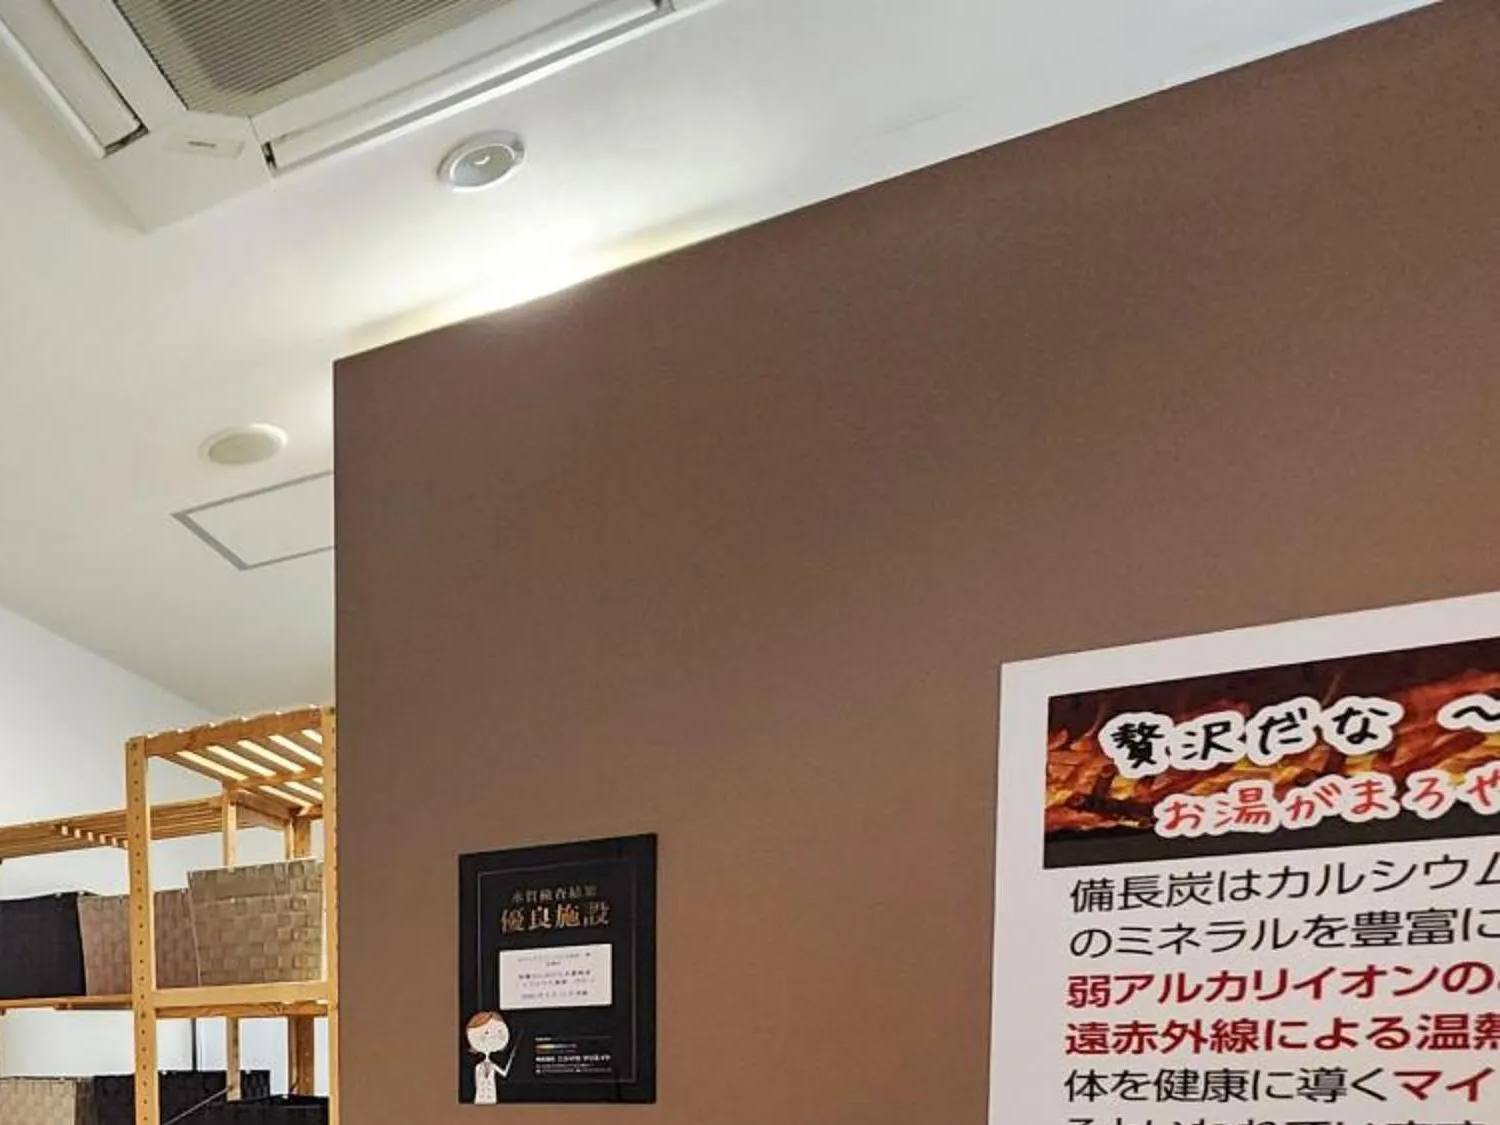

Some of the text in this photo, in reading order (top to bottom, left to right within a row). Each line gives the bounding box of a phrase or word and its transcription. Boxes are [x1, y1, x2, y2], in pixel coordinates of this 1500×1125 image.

[1111, 705, 1391, 769] 贅沢だな
[1163, 769, 1500, 831] お湯がまろや
[500, 902, 611, 935] 優良施設
[1069, 907, 1500, 958] のミネラルを豊富に
[1065, 961, 1500, 1009] 弱アルカリイオンの
